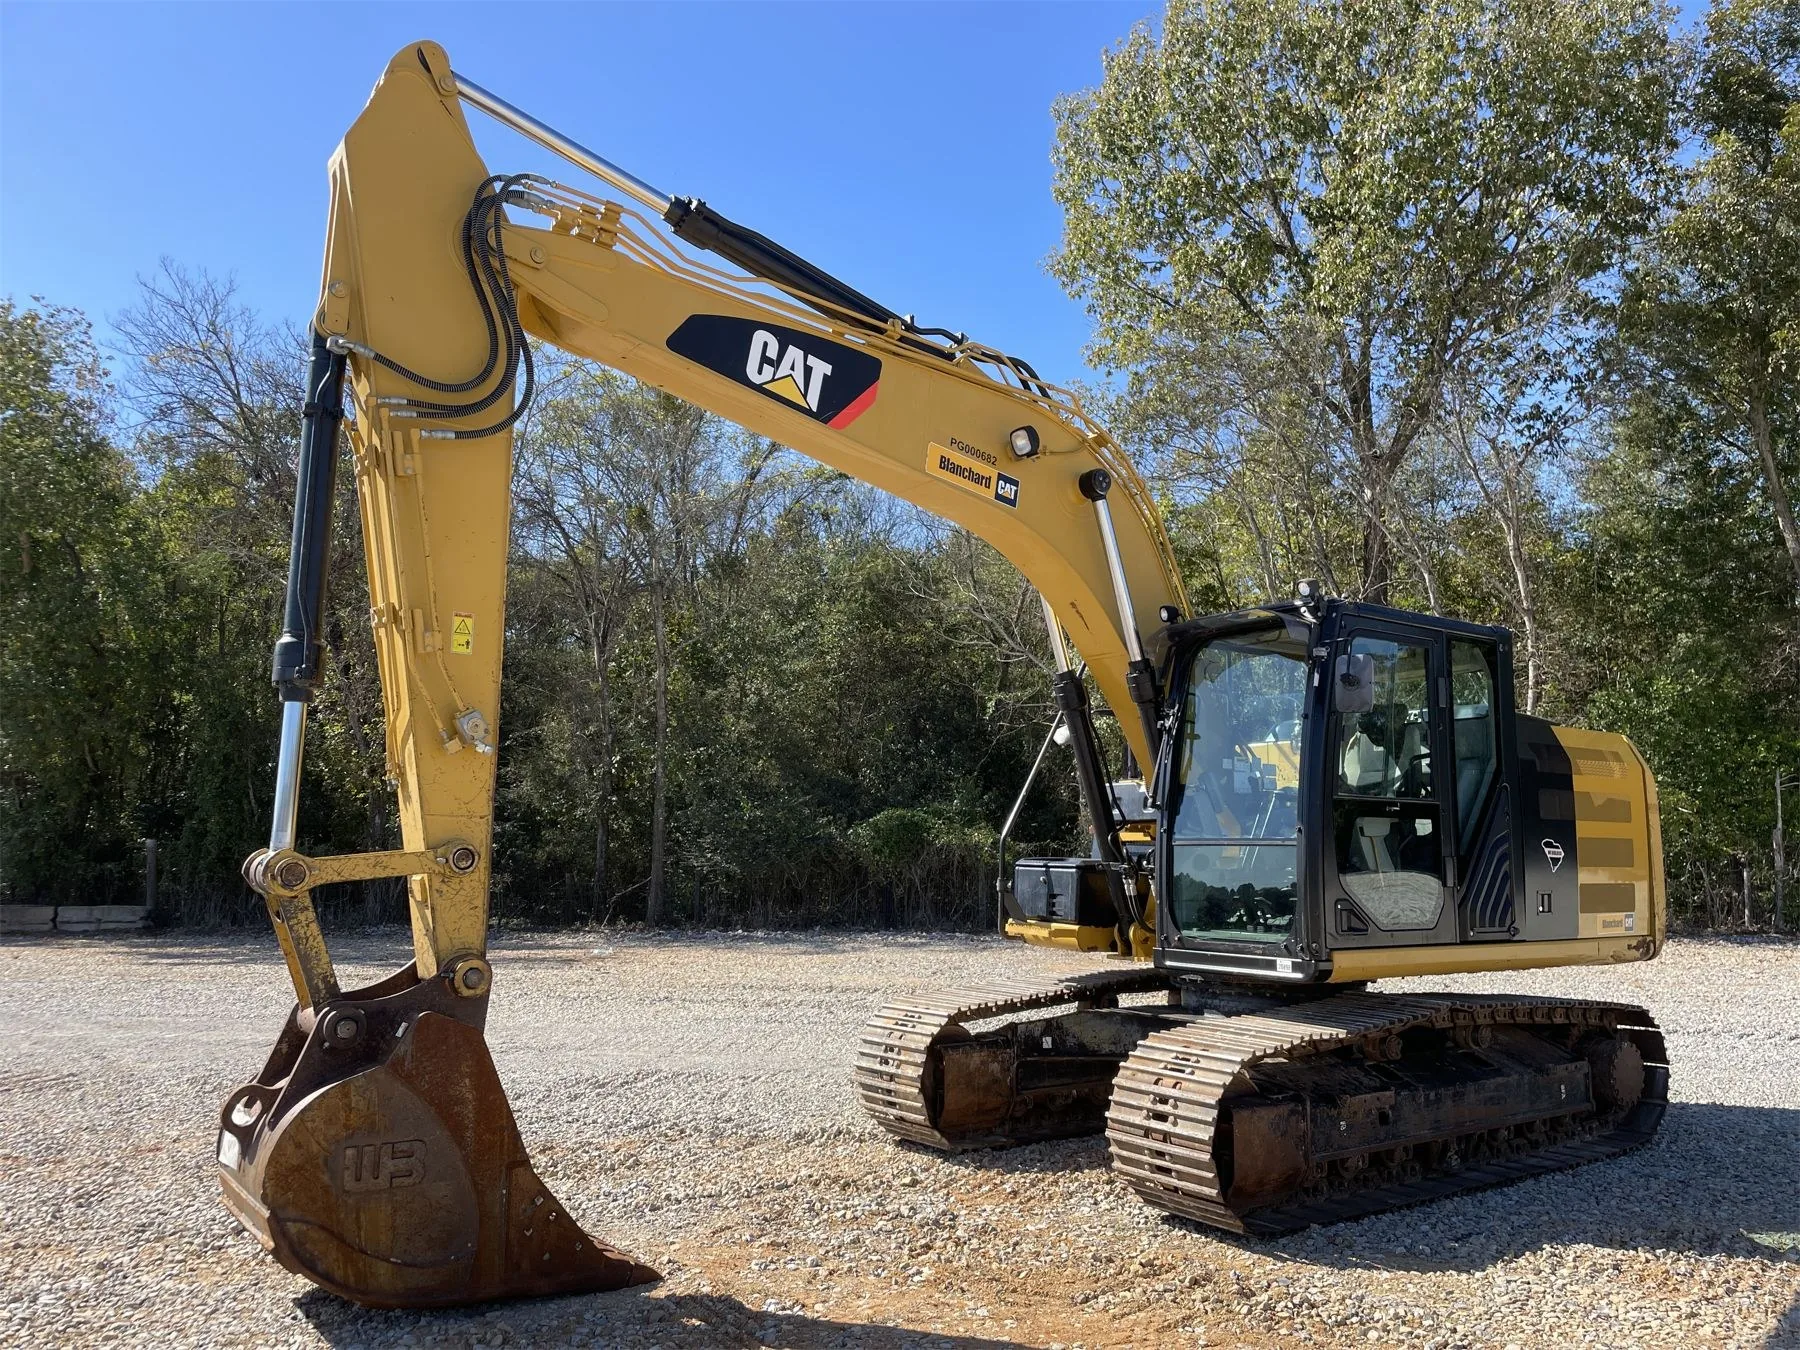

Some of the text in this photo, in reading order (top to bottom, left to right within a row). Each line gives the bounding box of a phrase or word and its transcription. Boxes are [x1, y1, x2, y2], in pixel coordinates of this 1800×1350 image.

[745, 329, 833, 413] CAT
[950, 437, 998, 466] PG000682
[939, 454, 1018, 500] Blanchard CAT
